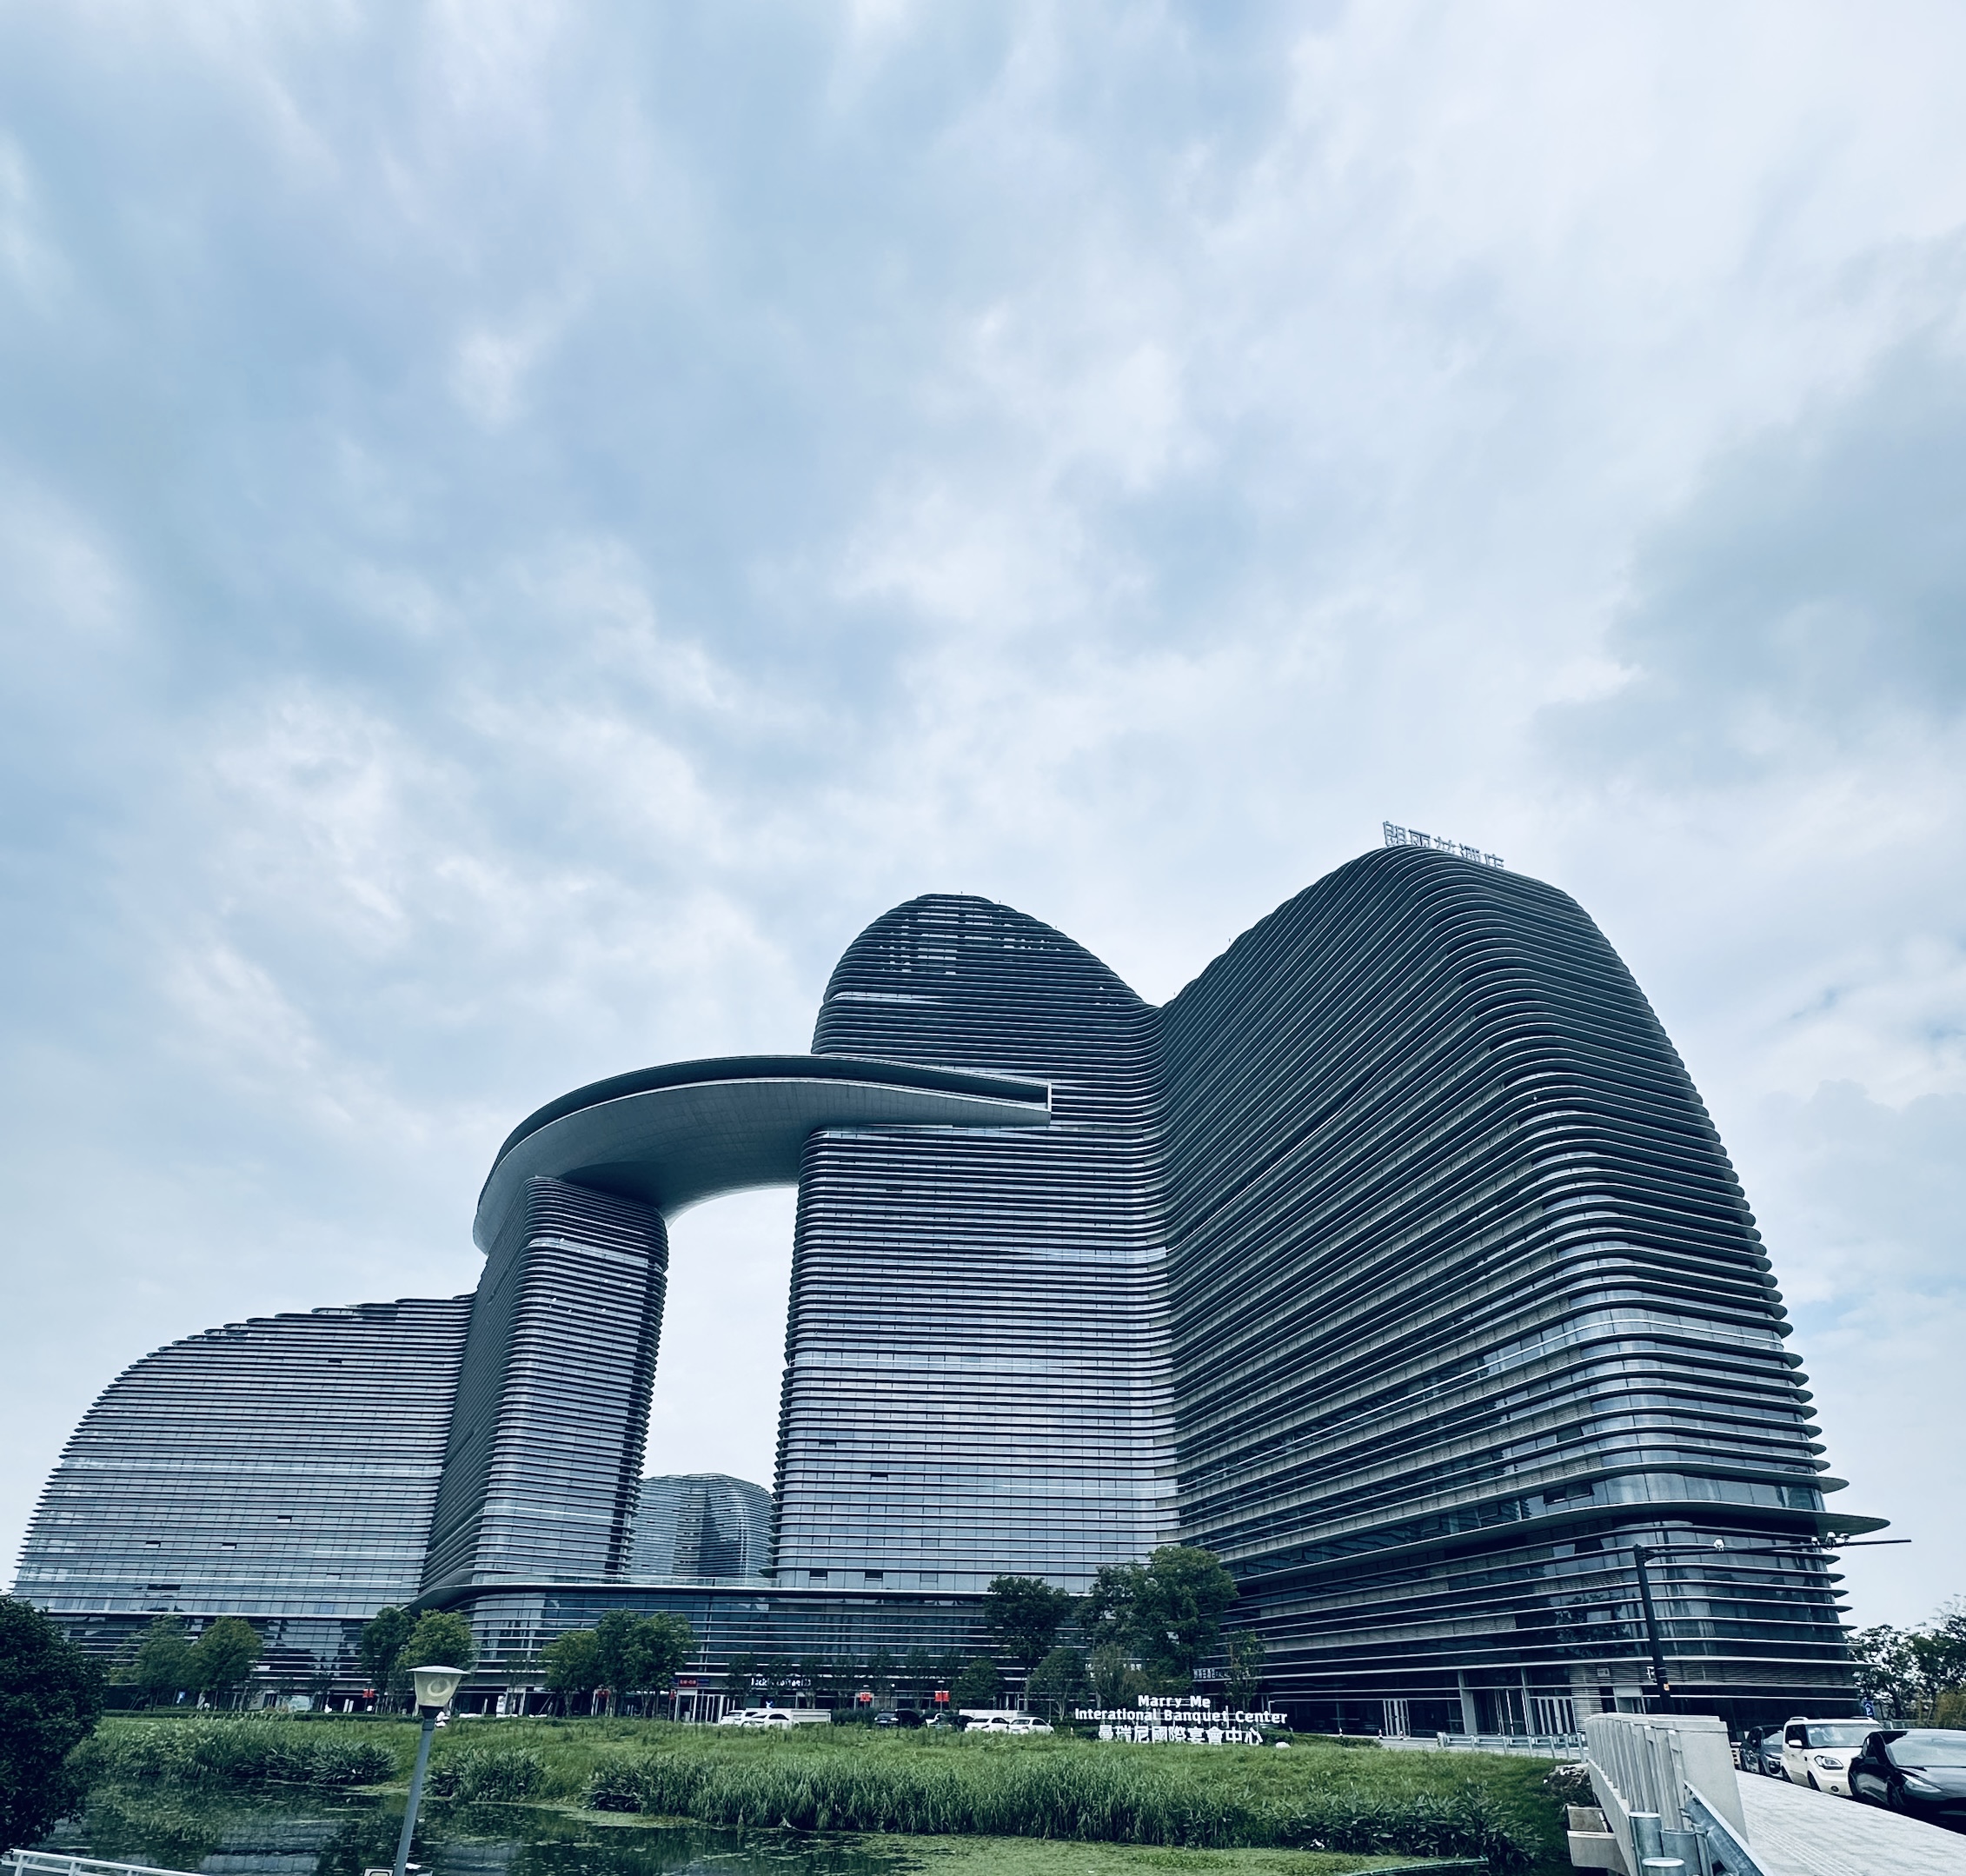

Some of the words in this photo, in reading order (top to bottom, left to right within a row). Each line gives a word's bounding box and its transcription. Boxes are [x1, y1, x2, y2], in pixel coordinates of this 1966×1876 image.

[1138, 1694, 1182, 1708] Marry
[1190, 1695, 1211, 1708] Me
[1075, 1707, 1158, 1721] Interational
[1164, 1709, 1229, 1725] Banquet
[1235, 1710, 1287, 1724] Center
